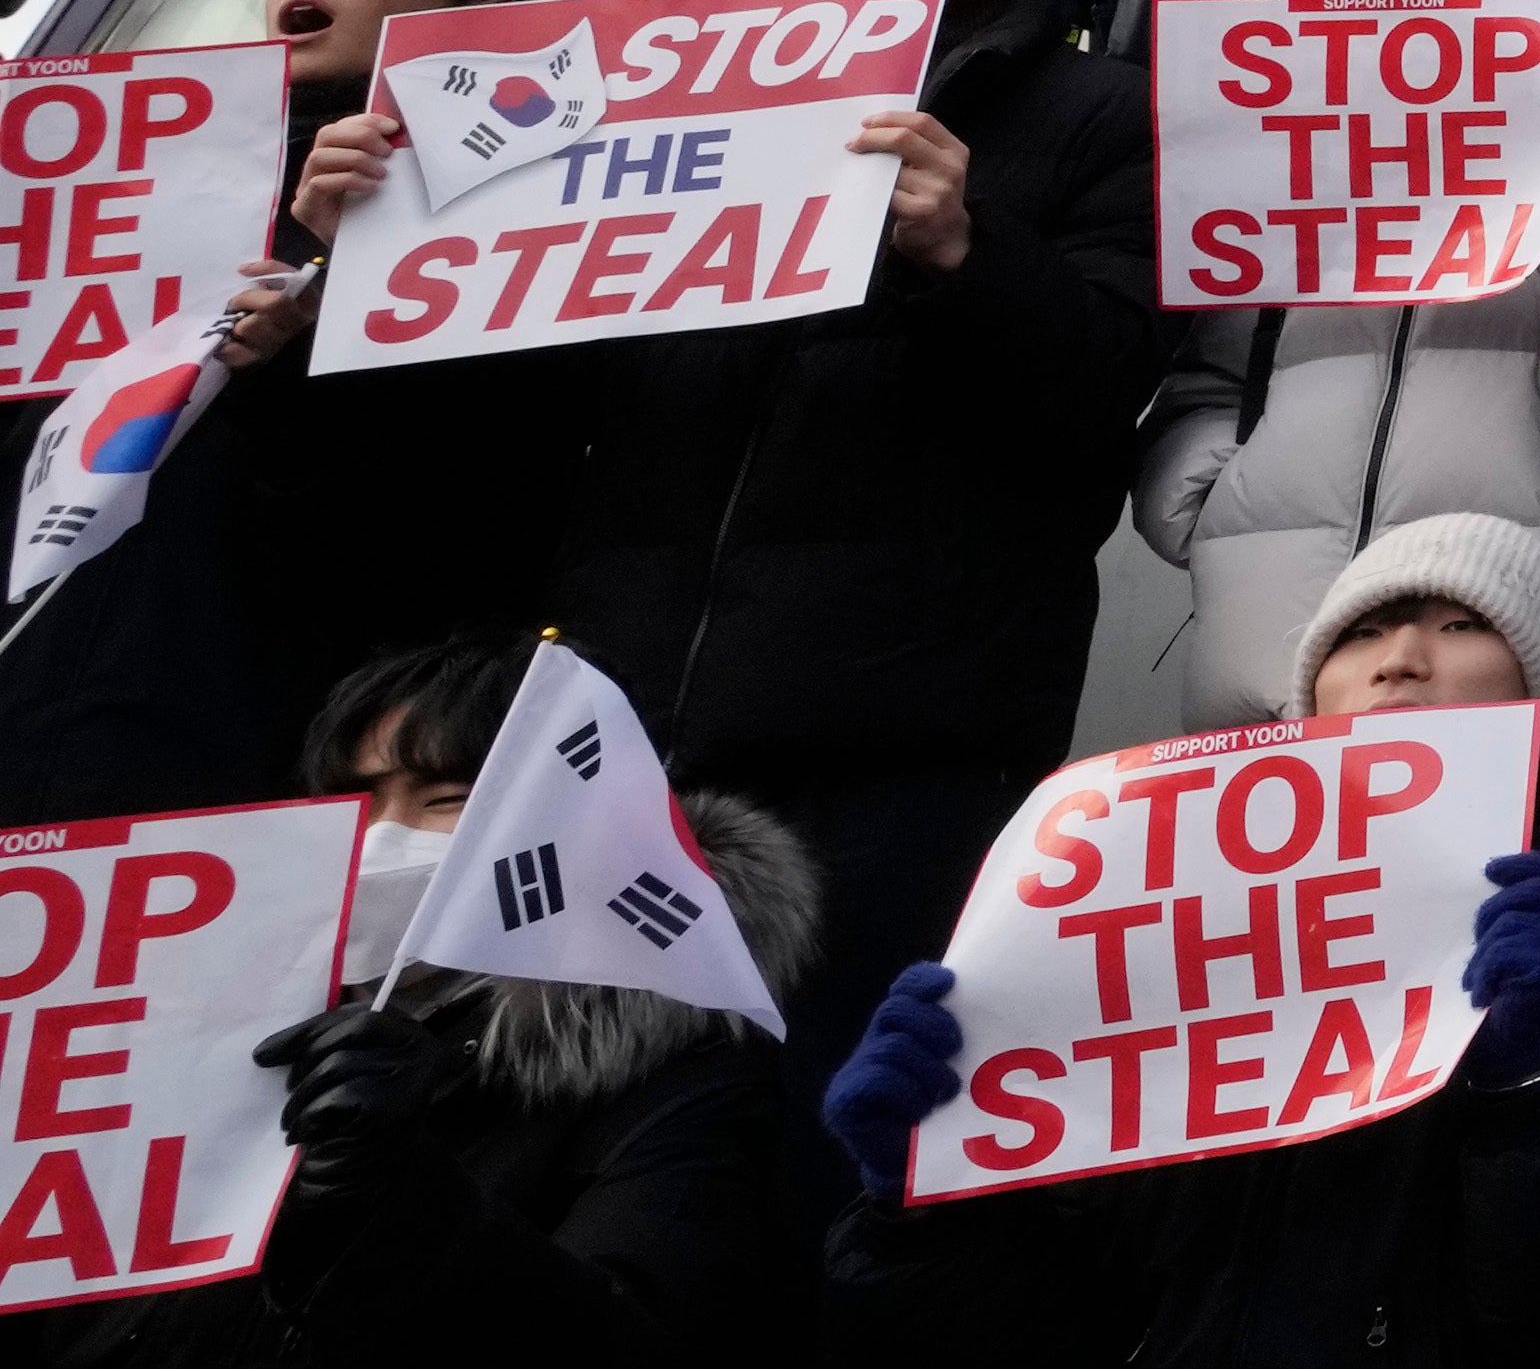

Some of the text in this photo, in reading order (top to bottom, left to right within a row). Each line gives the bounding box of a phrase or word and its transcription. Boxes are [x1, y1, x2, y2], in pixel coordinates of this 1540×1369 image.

[26, 58, 90, 76] YOON
[0, 76, 214, 180] OP
[552, 128, 732, 207] THE
[1261, 109, 1507, 201] THE
[0, 178, 155, 282] HE
[364, 193, 832, 346] STEAL
[1187, 202, 1535, 299] STEAL
[1151, 721, 1305, 764] SUPPORT YOON
[1015, 739, 1444, 910] STOP
[0, 850, 237, 1001] OP
[1058, 866, 1387, 1025] THE
[961, 984, 1449, 1173] STEAL
